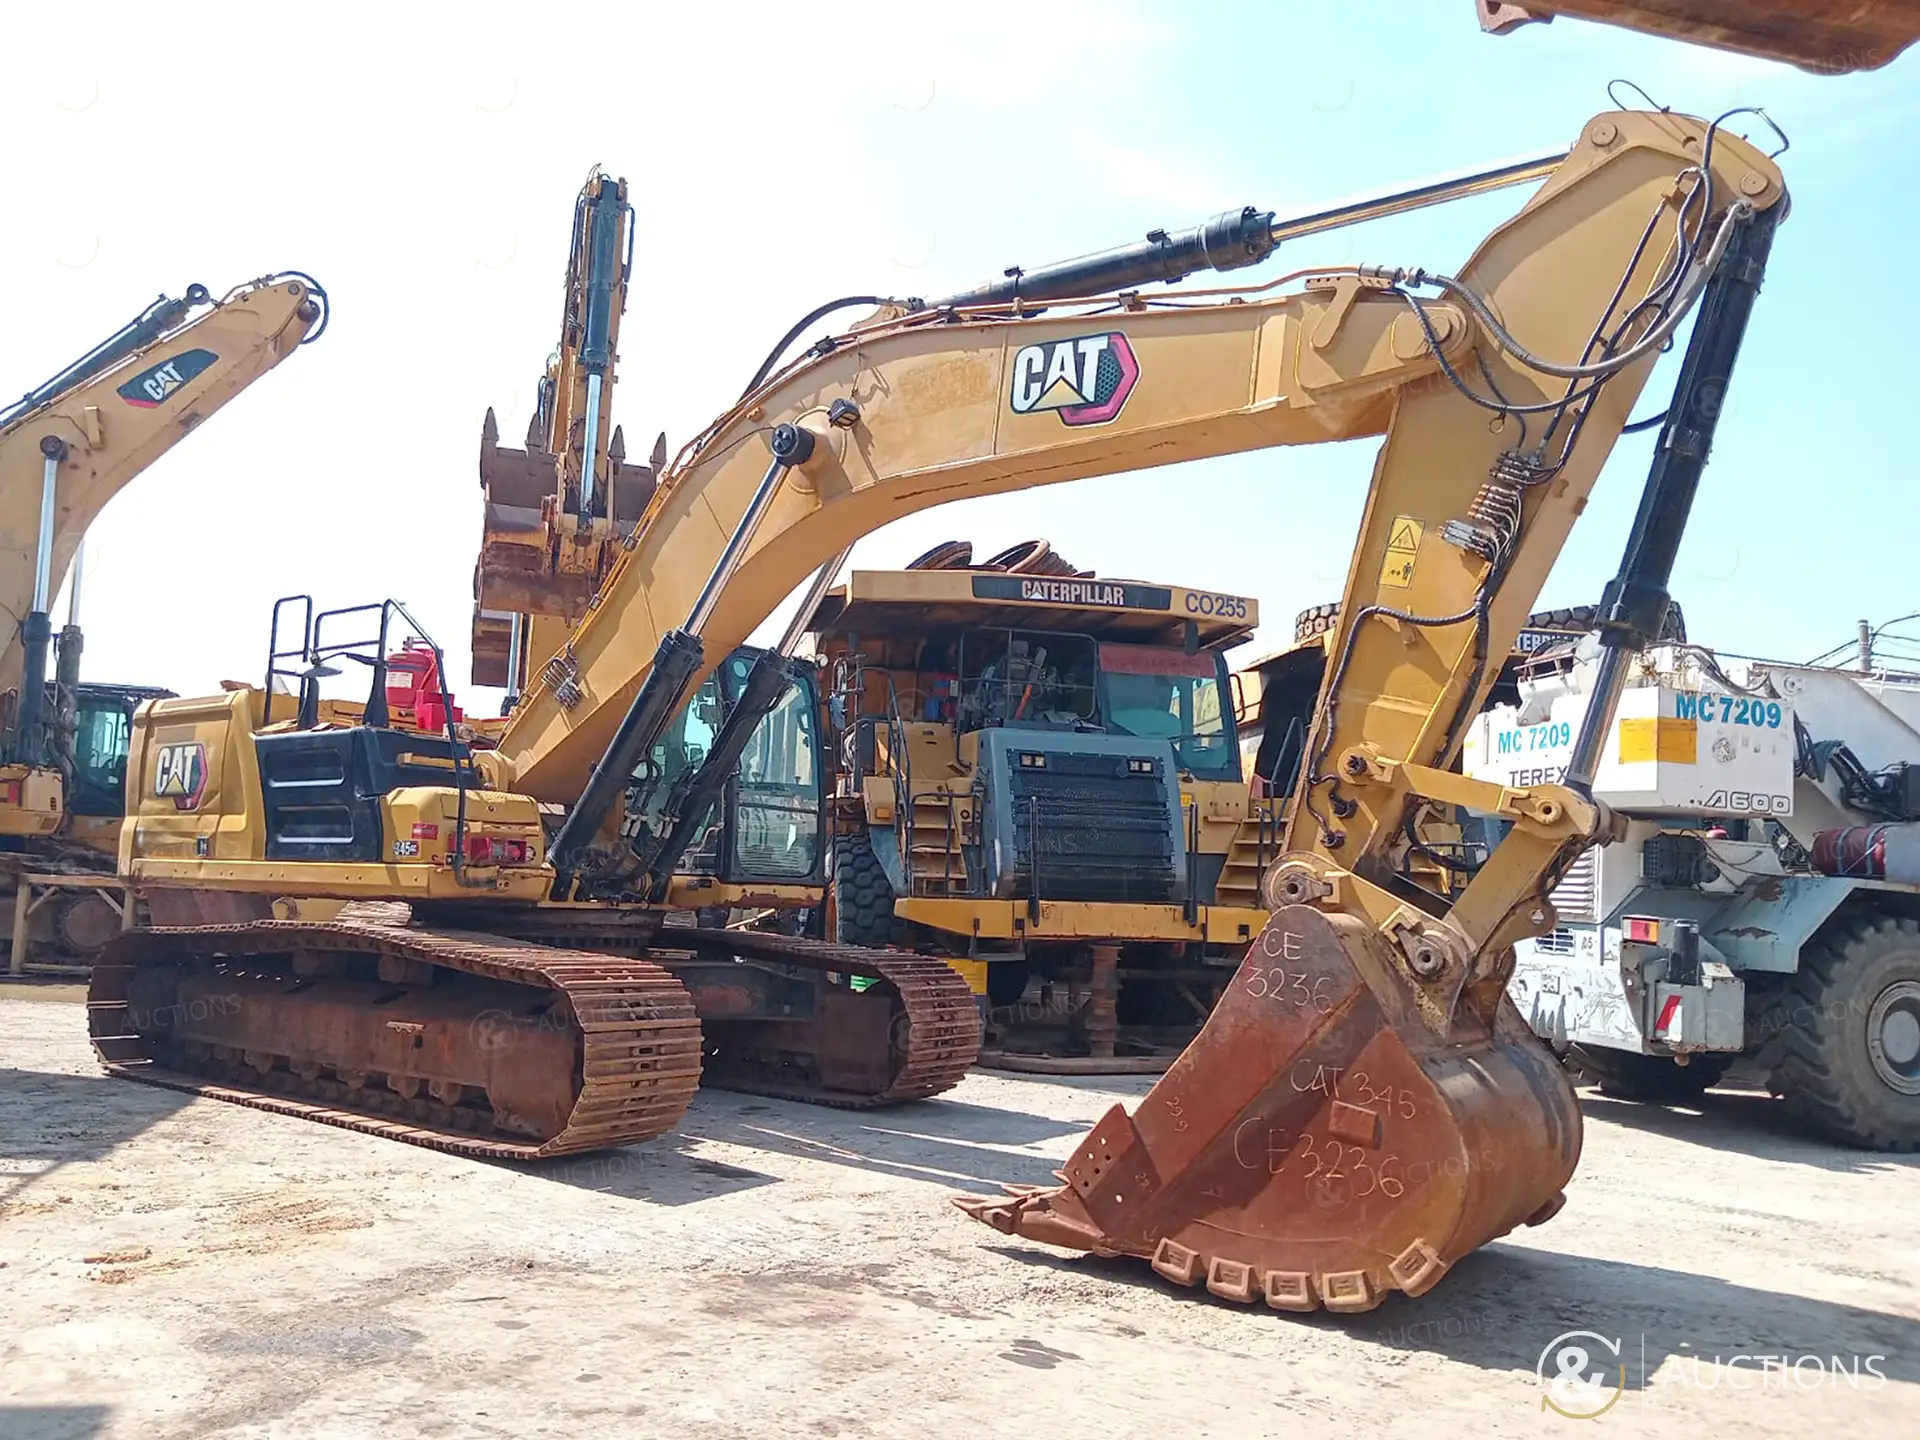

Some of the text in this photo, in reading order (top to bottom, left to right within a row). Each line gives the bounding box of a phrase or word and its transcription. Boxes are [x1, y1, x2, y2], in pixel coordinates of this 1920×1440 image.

[143, 361, 184, 401] CAT
[1012, 335, 1109, 412] CAT
[1022, 580, 1125, 606] CATERPILLAR
[1185, 592, 1247, 619] CO255
[1675, 692, 1781, 729] MC 7209
[1498, 721, 1570, 754] MC 7209
[155, 745, 198, 796] CAT
[1509, 765, 1568, 788] TEREX
[1703, 789, 1790, 814] A600
[1263, 927, 1304, 960] CE
[1246, 967, 1333, 1014] 3236
[1290, 1059, 1415, 1119] CAT 345
[1234, 1117, 1405, 1197] CE 3236
